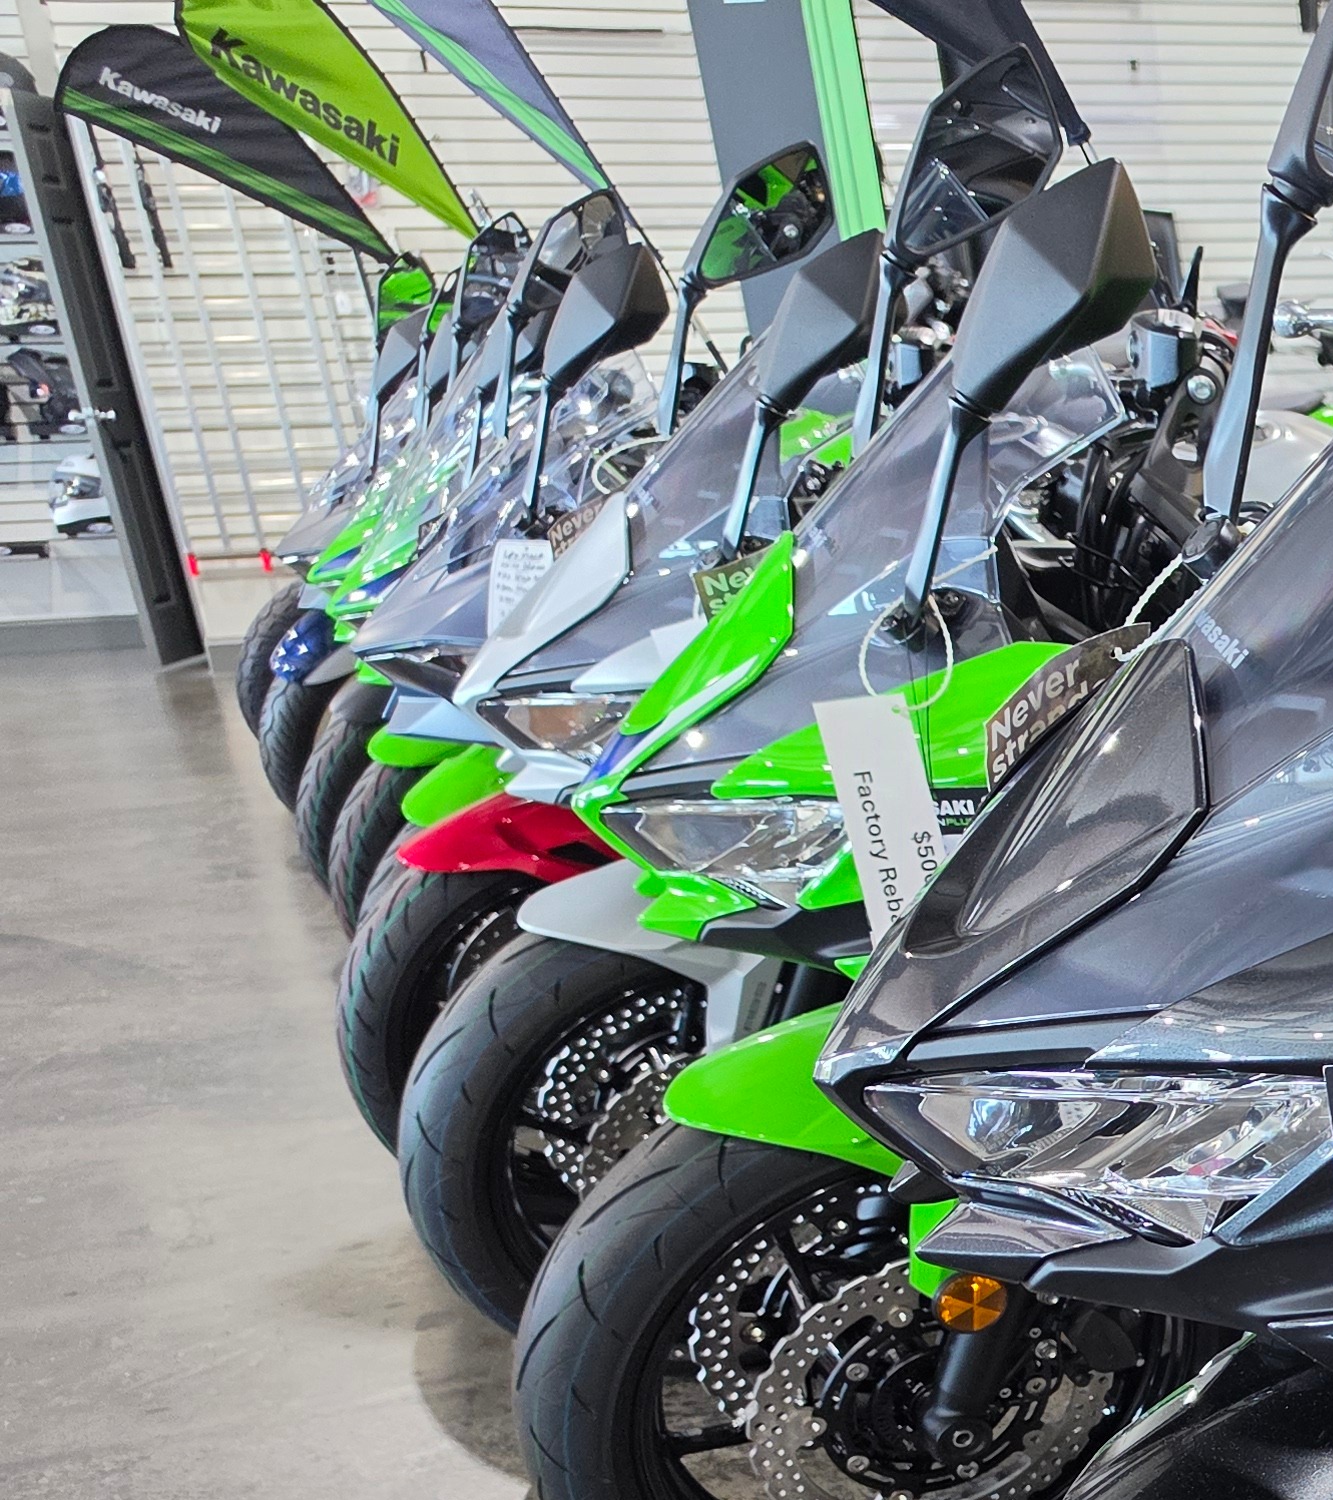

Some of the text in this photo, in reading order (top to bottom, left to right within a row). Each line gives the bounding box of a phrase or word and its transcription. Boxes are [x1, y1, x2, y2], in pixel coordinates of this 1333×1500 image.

[99, 66, 221, 134] Kawasaki
[209, 27, 400, 167] Kawasaki
[550, 503, 602, 548] Never
[991, 659, 1079, 752] Never
[992, 678, 1106, 783] strand
[853, 771, 889, 861] Factory
[911, 830, 939, 883] $50
